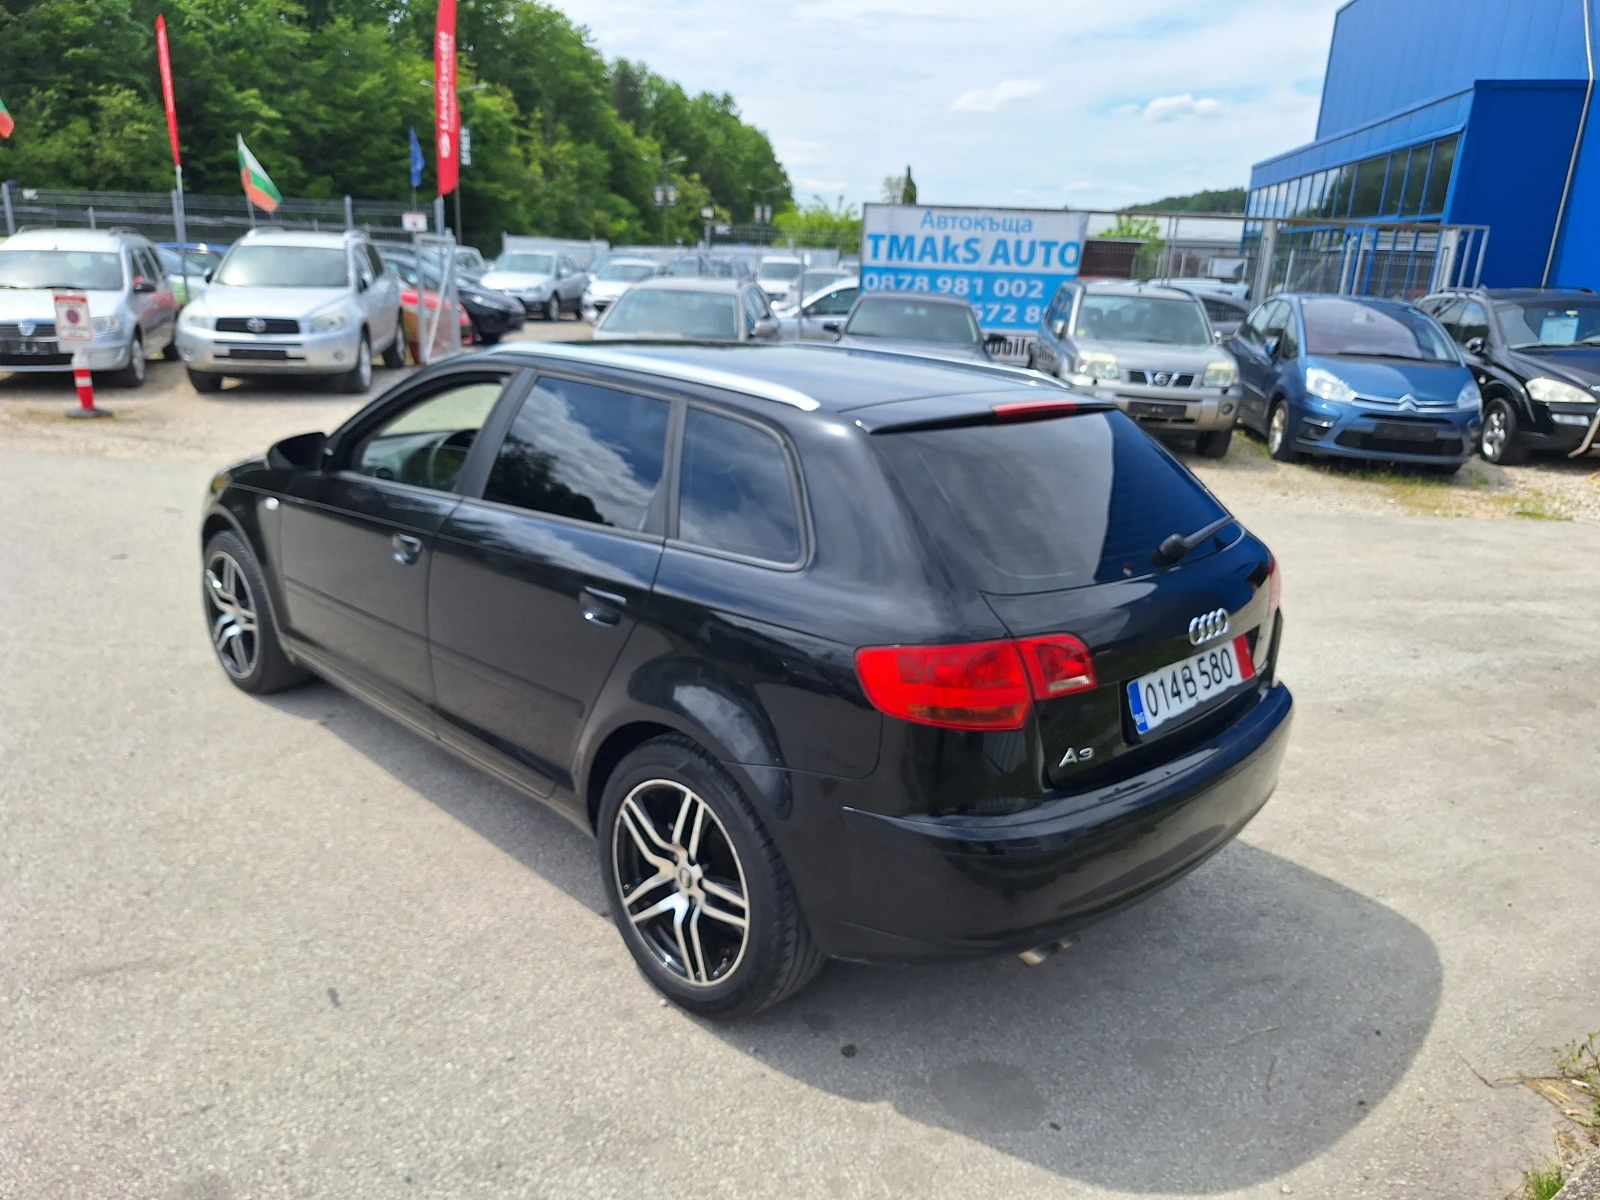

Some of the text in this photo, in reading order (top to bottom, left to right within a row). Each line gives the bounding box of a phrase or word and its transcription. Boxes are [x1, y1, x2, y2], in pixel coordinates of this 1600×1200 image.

[919, 210, 1033, 234] Автокъща
[867, 234, 1080, 269] TMAkS AUTO
[863, 273, 1044, 299] 0878 981 002
[1024, 305, 1048, 324] 8
[1144, 647, 1234, 717] 014B 580
[1058, 745, 1094, 768] A3
